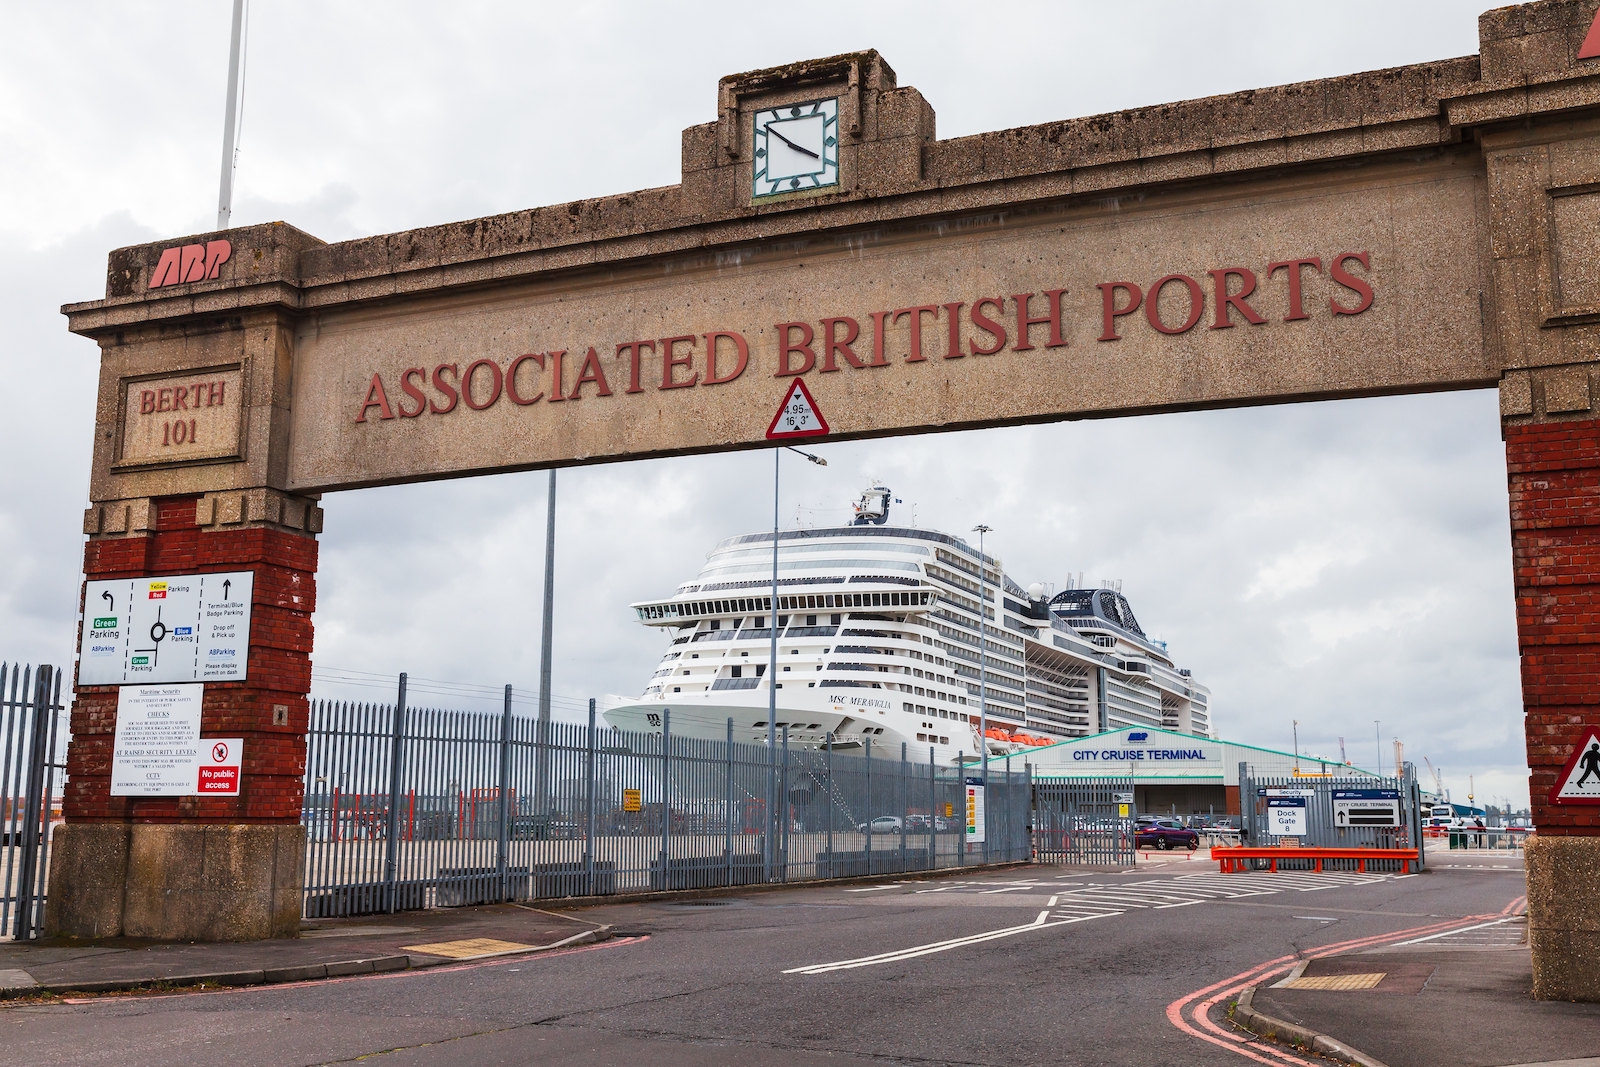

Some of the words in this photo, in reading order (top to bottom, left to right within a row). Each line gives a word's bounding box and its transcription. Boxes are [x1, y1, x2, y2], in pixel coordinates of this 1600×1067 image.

[148, 239, 232, 289] ABP
[354, 330, 750, 423] ASSOCIATED
[773, 288, 1069, 378] BRITISH
[1096, 250, 1374, 342] PORTS
[139, 380, 226, 415] BERTH
[162, 419, 197, 446] 101
[94, 619, 116, 627] Green
[90, 630, 120, 639] Parking
[828, 695, 847, 704] MSC
[850, 697, 890, 709] MERAVIGLIA
[1073, 750, 1099, 760] CITY
[1101, 750, 1144, 760] CRUISE
[1147, 750, 1206, 760] TERMINAL
[202, 770, 212, 778] No
[213, 770, 235, 779] public
